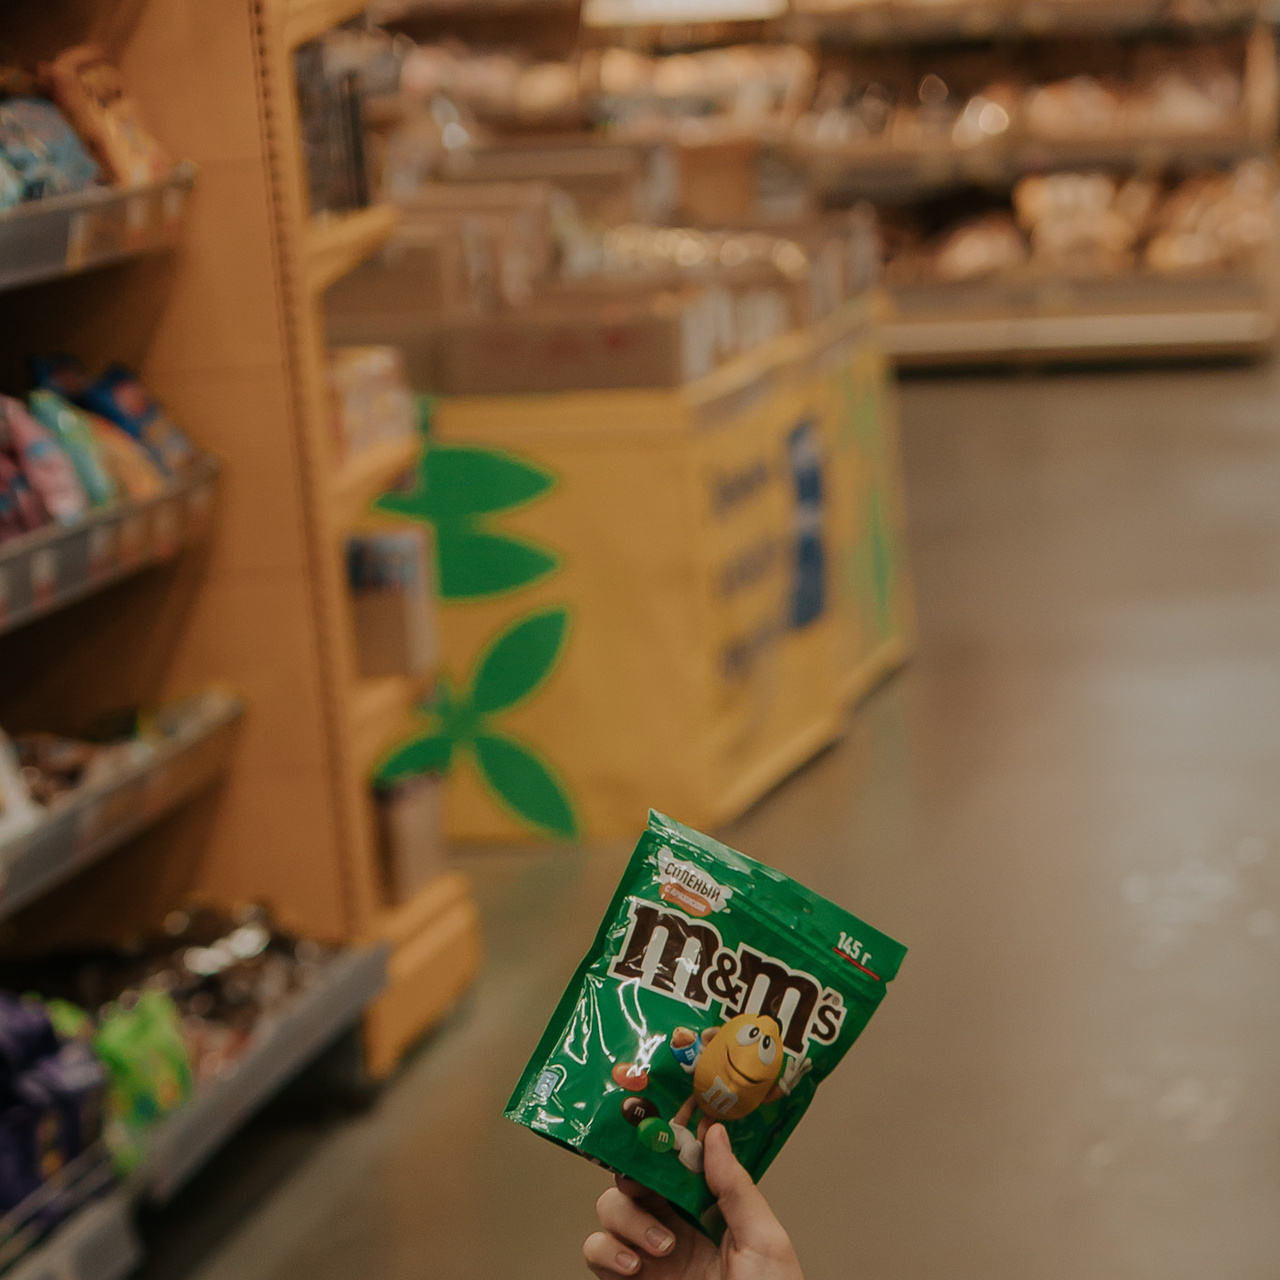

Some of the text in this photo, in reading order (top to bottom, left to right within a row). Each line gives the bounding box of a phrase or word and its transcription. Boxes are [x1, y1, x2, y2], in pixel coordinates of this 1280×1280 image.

[837, 931, 872, 966] 145 г
[657, 1130, 669, 1143] m
